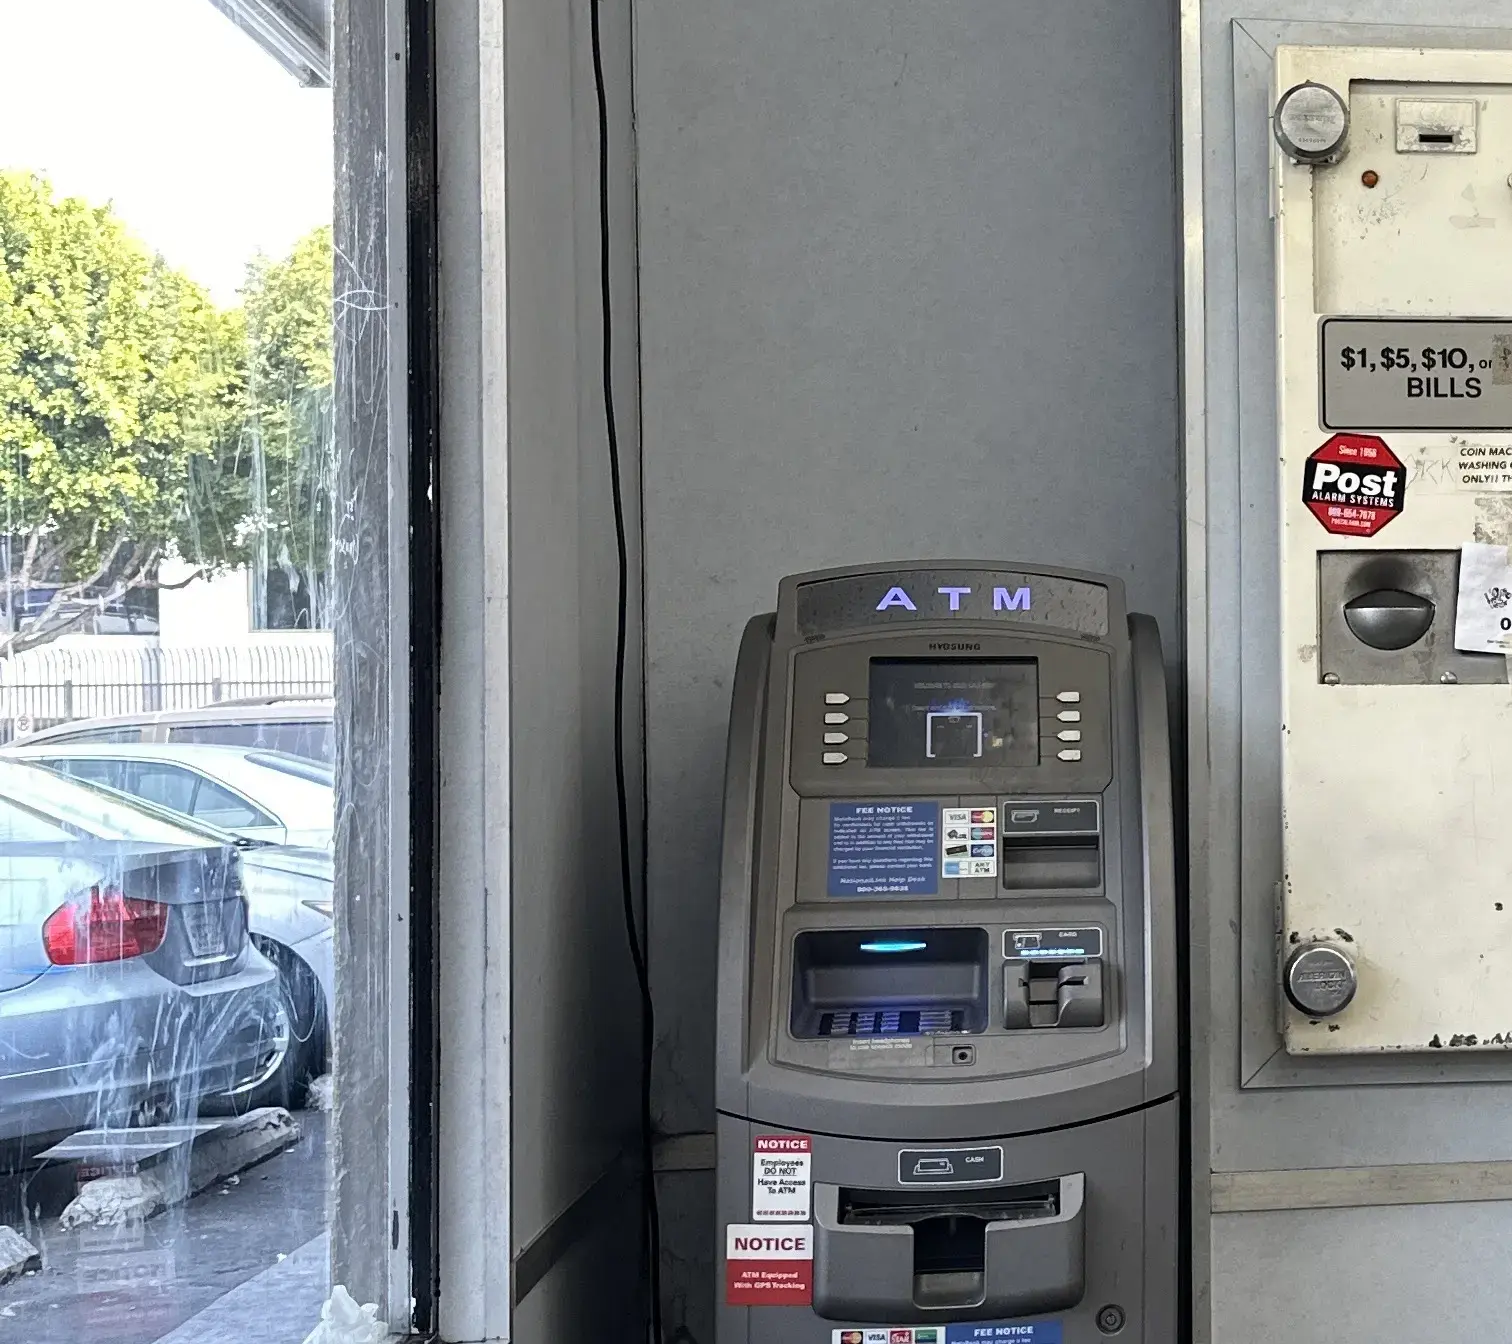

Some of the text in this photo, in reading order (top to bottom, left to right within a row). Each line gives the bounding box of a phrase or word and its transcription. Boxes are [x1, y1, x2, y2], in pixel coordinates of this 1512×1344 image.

[1341, 347, 1376, 372] $1,
[1380, 347, 1416, 372] $5,
[1422, 347, 1474, 372] $10,
[1479, 358, 1492, 369] or
[1407, 378, 1481, 398] BILLS
[1339, 445, 1357, 456] Since
[1460, 448, 1486, 456] COIN
[1459, 461, 1507, 470] WASHING
[1313, 463, 1397, 497] Post
[1462, 475, 1498, 484] ONLY!!
[1312, 491, 1394, 507] ALARM SYSTEMS
[876, 587, 1031, 610] ATM
[758, 1140, 808, 1149] NOTICE
[760, 1159, 803, 1168] Employees
[779, 1167, 797, 1175] NOT
[778, 1186, 796, 1194] ATM
[735, 1237, 806, 1251] NOTICE
[761, 1271, 798, 1280] Equipped
[754, 1281, 772, 1289] GPS
[772, 1281, 805, 1290] Tracking
[974, 1326, 1033, 1337] FEE NOTICE
